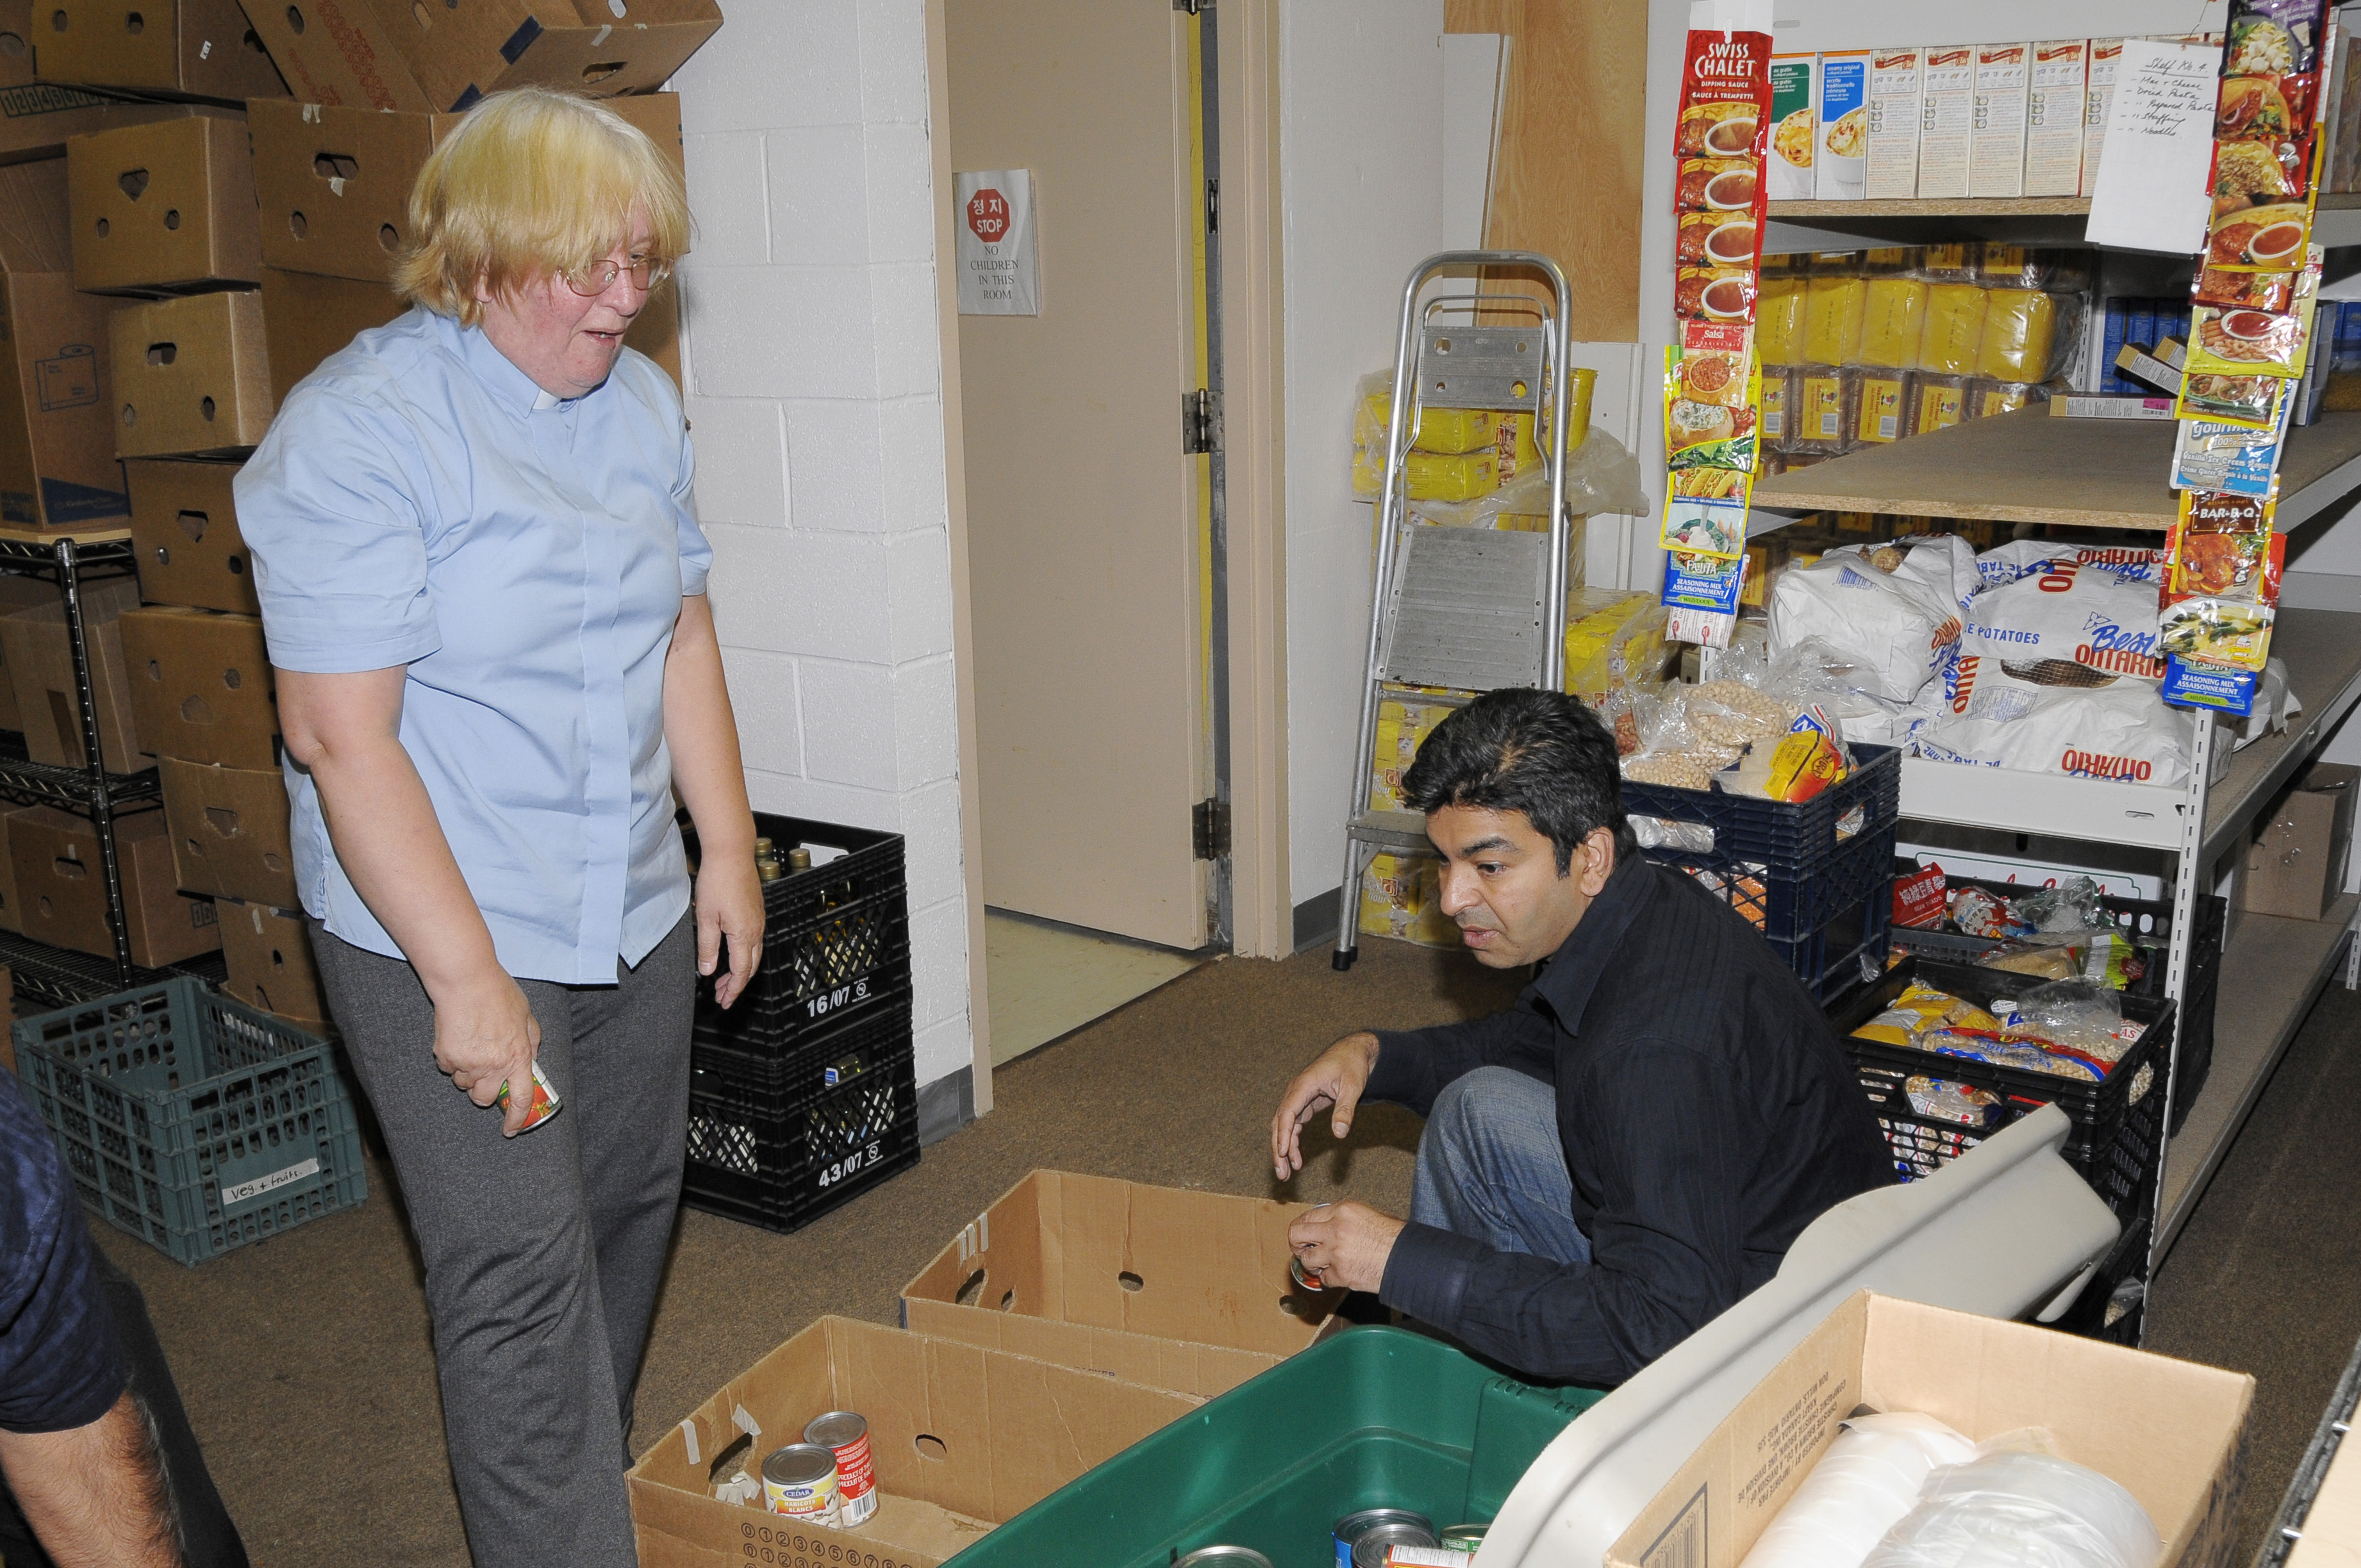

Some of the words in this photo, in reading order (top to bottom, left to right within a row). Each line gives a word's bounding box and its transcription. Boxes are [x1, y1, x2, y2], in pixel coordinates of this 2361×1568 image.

[1709, 43, 1749, 58] SWISS
[1694, 54, 1756, 78] CHALET
[2146, 58, 2176, 76] Shelf
[6, 95, 13, 110] 1
[16, 94, 26, 109] 2
[28, 92, 37, 108] 3
[41, 90, 50, 104] 4
[977, 219, 1002, 233] STOP
[984, 245, 998, 256] NO
[970, 260, 1019, 270] CHILDREN
[978, 275, 988, 285] IN
[991, 275, 1015, 285] THIS
[983, 290, 1012, 300] ROOM
[1704, 329, 1724, 338] Salsa
[2214, 436, 2236, 446] 100%
[2183, 451, 2205, 461] Vanilla
[2207, 454, 2219, 463] Ice
[2222, 456, 2246, 466] Cream
[2180, 465, 2198, 474] Crème
[2217, 470, 2236, 479] Royale
[2200, 508, 2255, 518] BAR-B-Q
[1687, 560, 1716, 574] FAJITA
[1673, 584, 1725, 596] ASSAISONNEMENT
[1677, 579, 1709, 588] SEASONING
[1978, 627, 2040, 645] POTATOES
[2091, 625, 2157, 659] Best
[2075, 643, 2169, 679] ONTARIO
[2177, 681, 2238, 695] ASSAISONNEMENT
[2182, 674, 2220, 686] SEASONING
[2221, 679, 2235, 688] MIX
[2061, 749, 2151, 781] ONTARIO
[808, 986, 850, 1018] 16/07
[819, 1151, 862, 1187] 43/07
[1819, 1371, 1828, 1389] DON
[1820, 1379, 1846, 1414] COMPAGNIE
[1782, 1399, 1802, 1428] ONTARIO
[1802, 1396, 1817, 1419] KRAFT
[1798, 1408, 1819, 1437] CHRISTIE
[1817, 1401, 1837, 1430] CHRISTIE
[1782, 1414, 1801, 1440] CANADA
[1800, 1423, 1816, 1448] BROWN
[1802, 1425, 1825, 1458] IMPORTED
[1768, 1453, 1778, 1468] UNE
[1795, 1453, 1802, 1467] BY
[838, 1469, 859, 1481] PRODUCT
[859, 1466, 863, 1474] OF
[1746, 1463, 1767, 1494] DIVISION
[1758, 1464, 1779, 1494] DIVISION
[838, 1477, 857, 1487] PRODUIT
[786, 1489, 810, 1498] CEDAR
[1738, 1489, 1744, 1504] DE
[1750, 1489, 1757, 1504] OF
[1759, 1489, 1769, 1508] PAR
